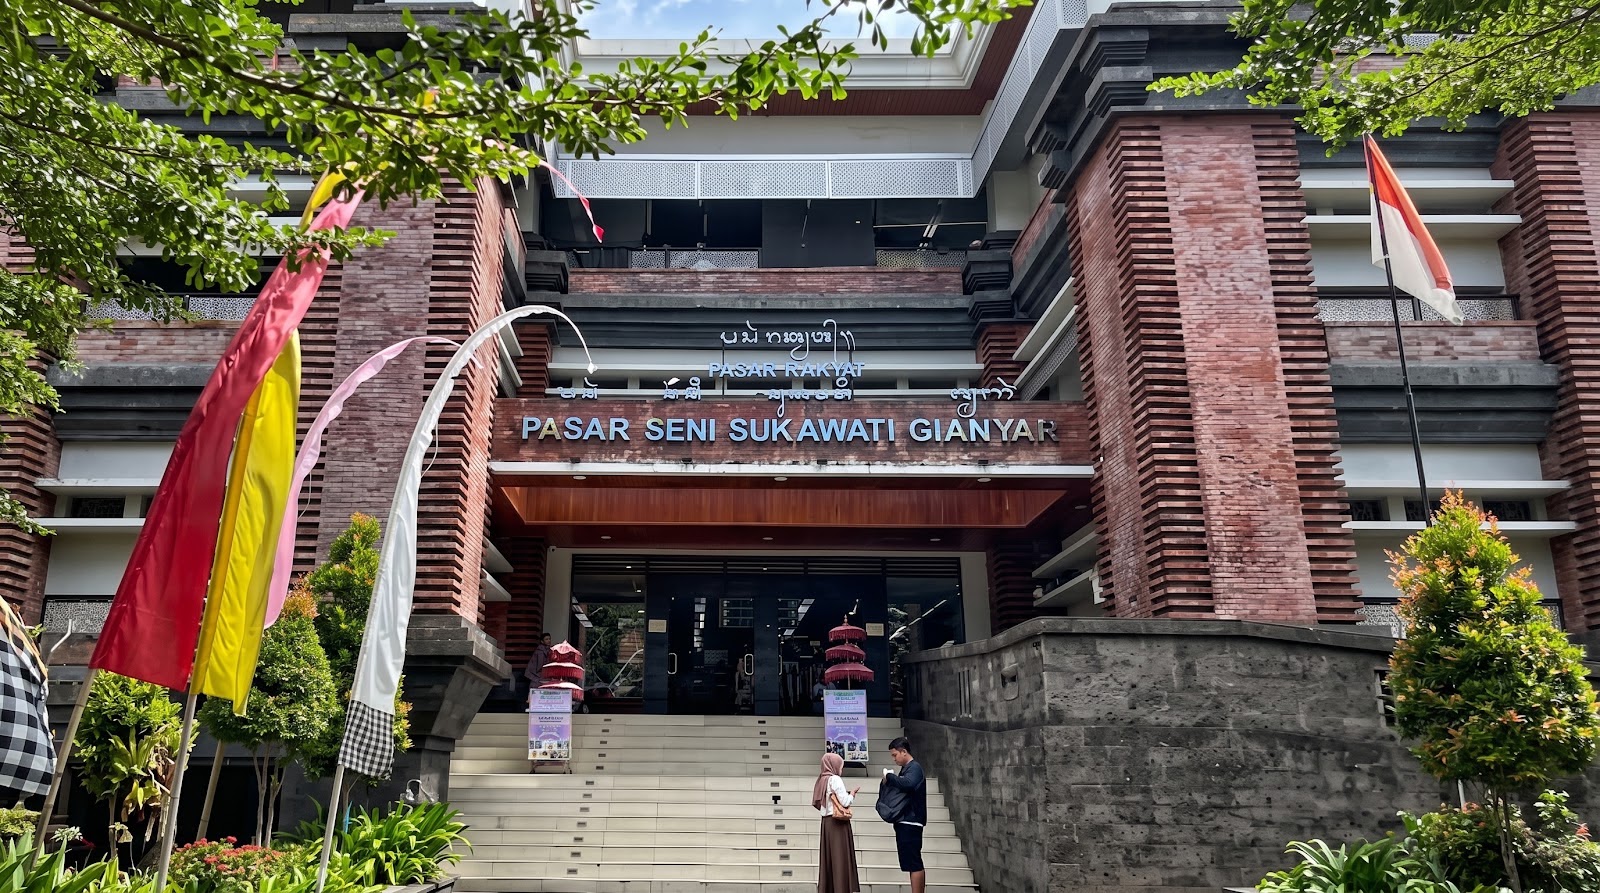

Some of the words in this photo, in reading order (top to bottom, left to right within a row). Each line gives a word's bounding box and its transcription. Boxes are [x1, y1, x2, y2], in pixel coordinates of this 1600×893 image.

[708, 362, 776, 378] PASAR
[785, 361, 865, 378] RAKYAT
[521, 416, 630, 441] PASAR
[645, 417, 716, 442] SENI
[728, 417, 895, 442] SUKAWATI
[909, 418, 1059, 442] GIANYAR
